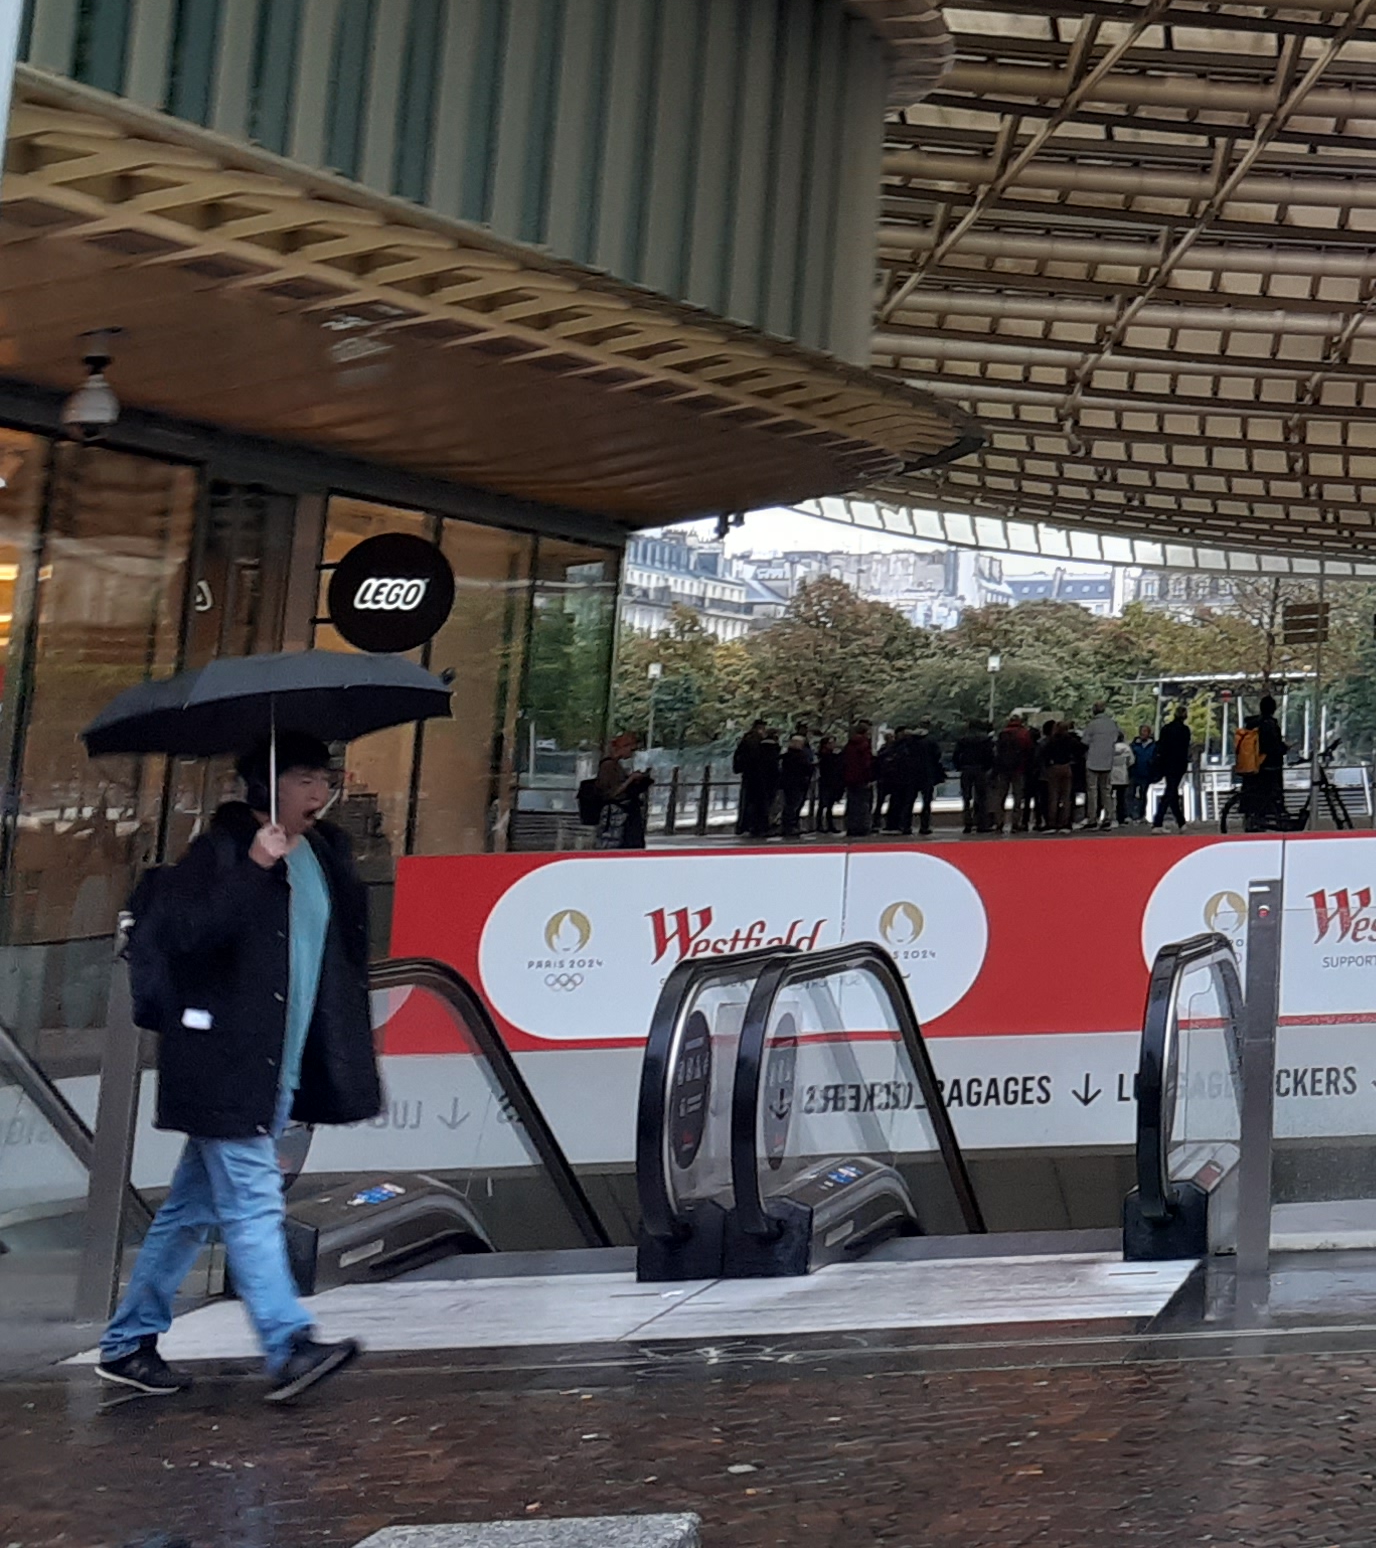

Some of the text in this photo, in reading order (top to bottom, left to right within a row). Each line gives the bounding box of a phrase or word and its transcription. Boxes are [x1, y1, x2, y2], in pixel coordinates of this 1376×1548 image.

[354, 578, 427, 611] LEGO
[527, 958, 604, 970] PARIS 2024
[903, 949, 936, 960] 2024
[1275, 1066, 1357, 1098] CKERS
